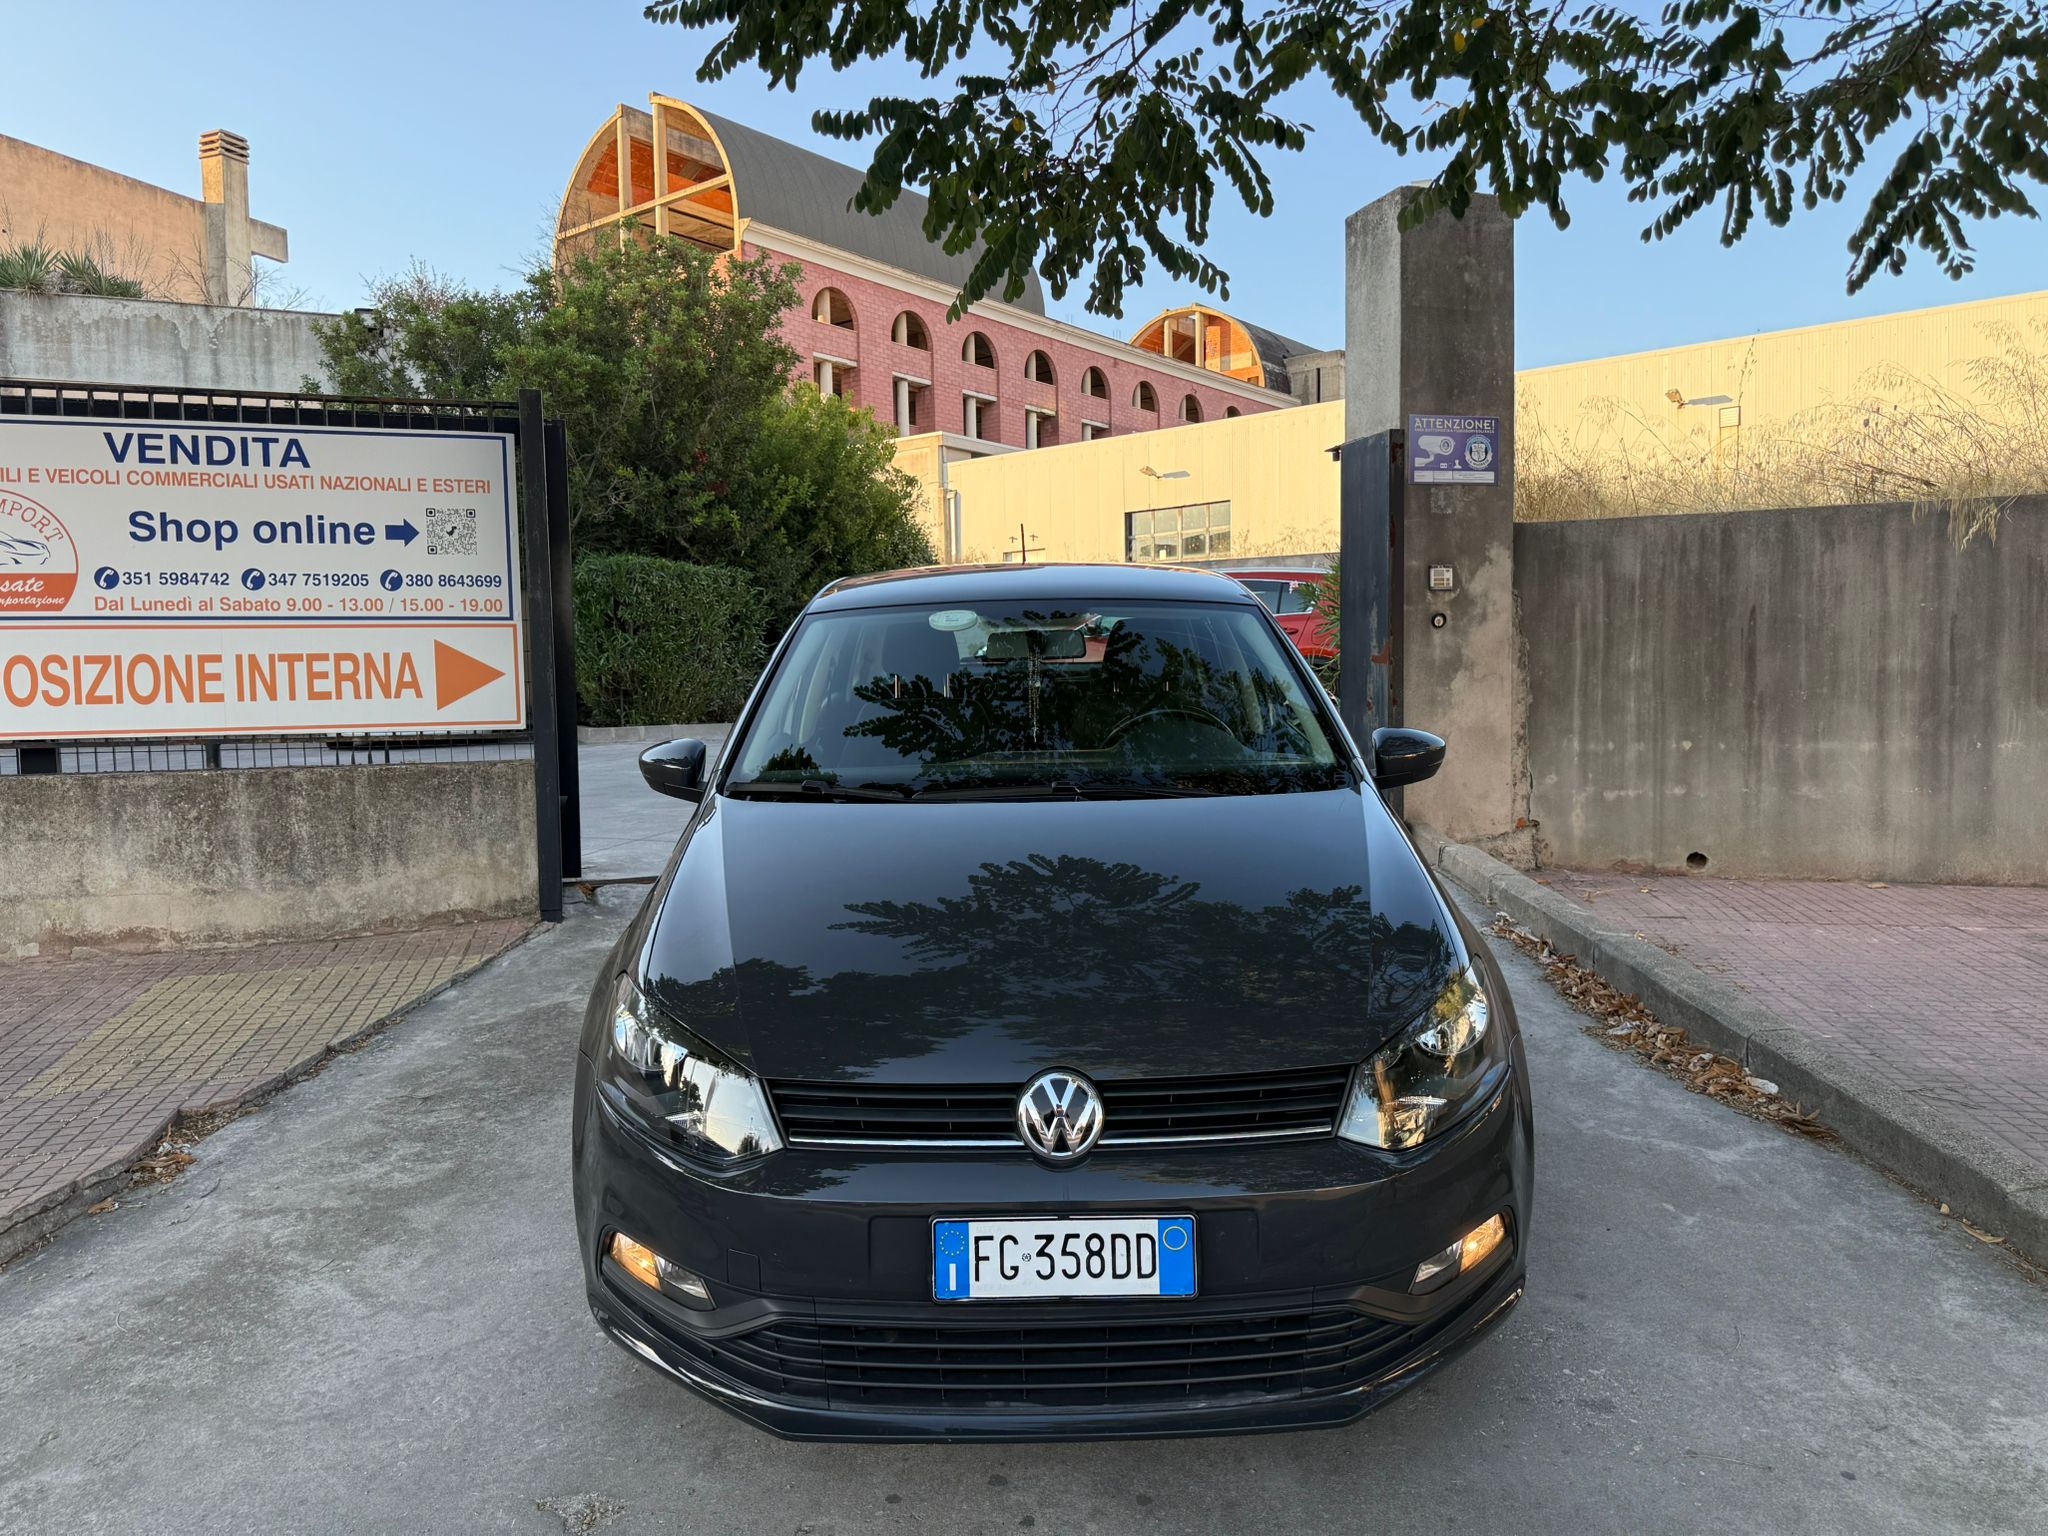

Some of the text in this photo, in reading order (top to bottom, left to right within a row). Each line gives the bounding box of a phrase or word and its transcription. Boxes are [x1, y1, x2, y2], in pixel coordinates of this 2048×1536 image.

[1414, 418, 1495, 430] ATTENZIONE!
[103, 432, 311, 469] VENDITA
[28, 467, 40, 483] E
[45, 469, 121, 485] VEICOLI
[126, 470, 258, 489] COMMERCIALI
[264, 474, 314, 490] USATI
[320, 475, 411, 493] NAZIONALI
[417, 478, 427, 493] E
[433, 479, 491, 494] ESTERI
[129, 511, 376, 550] Shop online
[122, 571, 502, 588] 351 5984742 347 7519205 380 8643699
[94, 597, 124, 612] Dal
[131, 596, 192, 612] Lunedì
[198, 597, 213, 612] al
[220, 597, 281, 612] Sabato
[287, 598, 323, 612] 9.00
[340, 598, 384, 612] 13.00
[401, 598, 444, 612] 15.00
[461, 599, 503, 613] 19.00
[3, 652, 424, 708] OSIZIONE INTERNA
